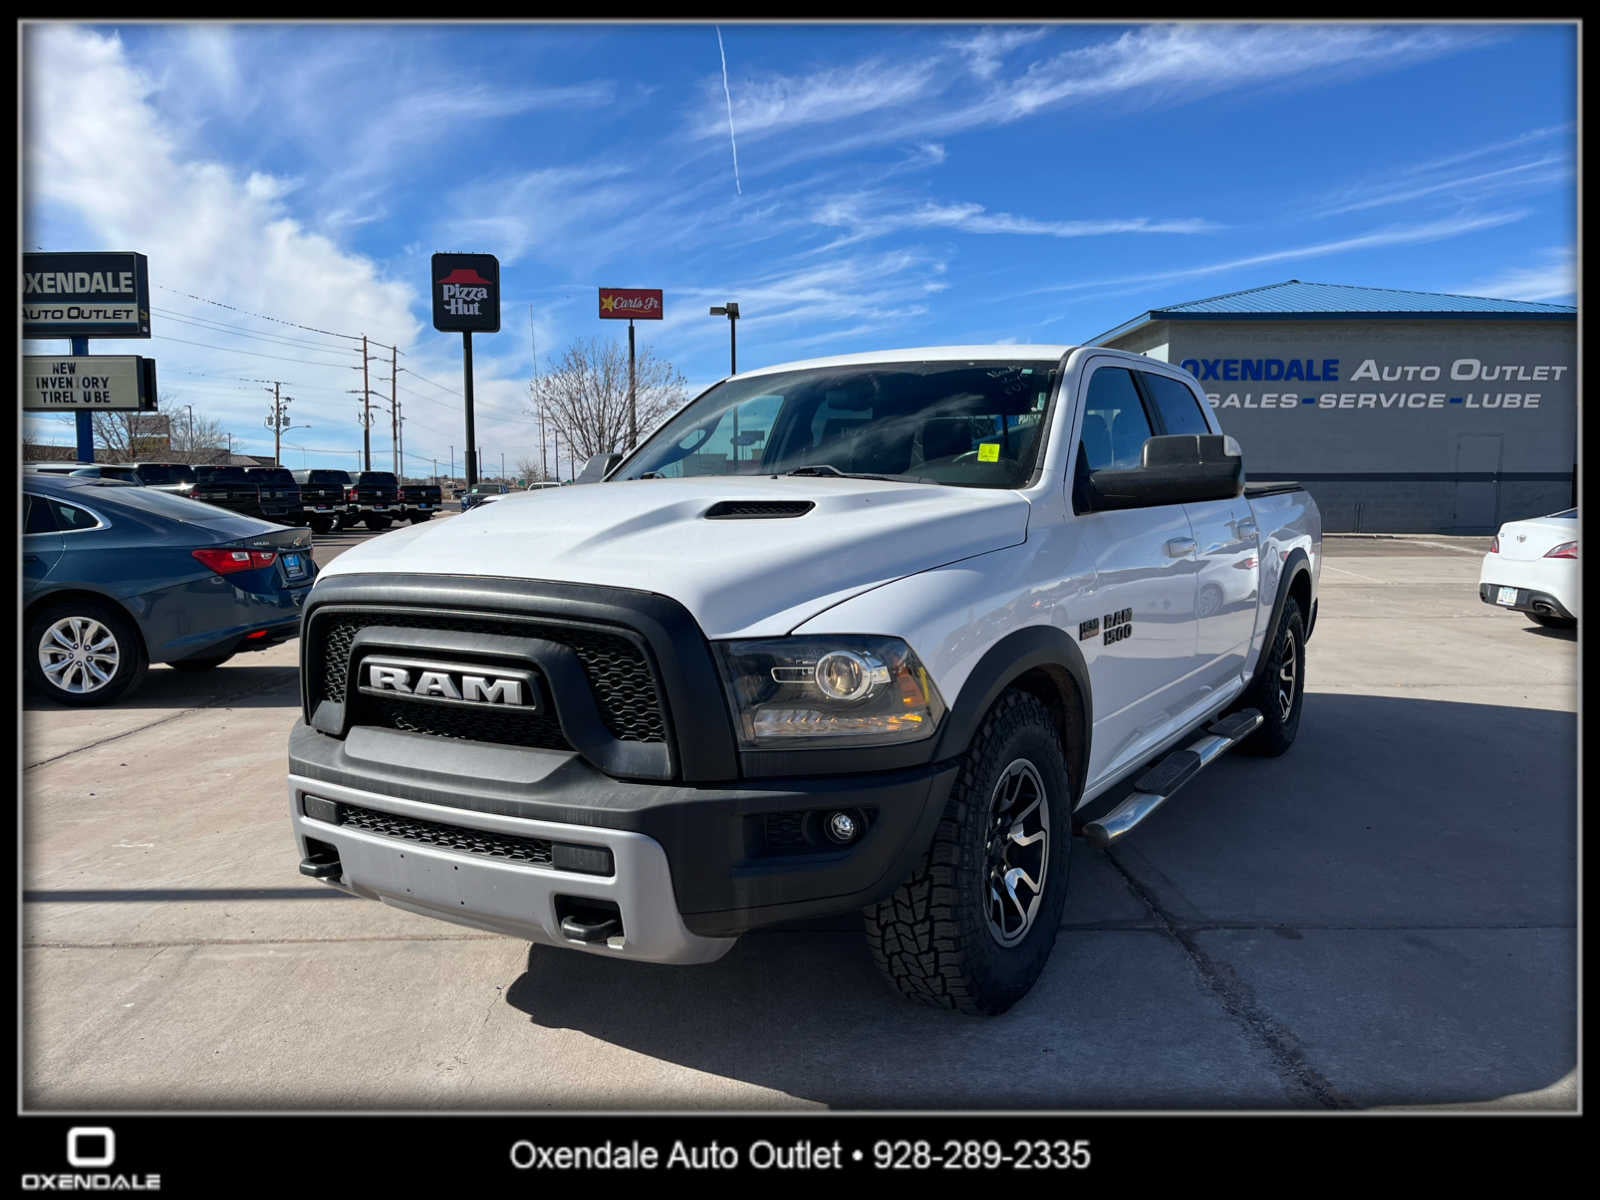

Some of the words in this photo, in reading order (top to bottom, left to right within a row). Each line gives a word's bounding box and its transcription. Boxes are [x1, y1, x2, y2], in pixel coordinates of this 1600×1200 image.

[23, 272, 134, 294] XENDALE
[443, 284, 488, 302] Pizza
[444, 299, 482, 316] Hut
[52, 362, 77, 375] NEW
[1181, 359, 1340, 381] OXENDALE
[1103, 623, 1132, 646] 1500
[369, 664, 522, 705] RAM
